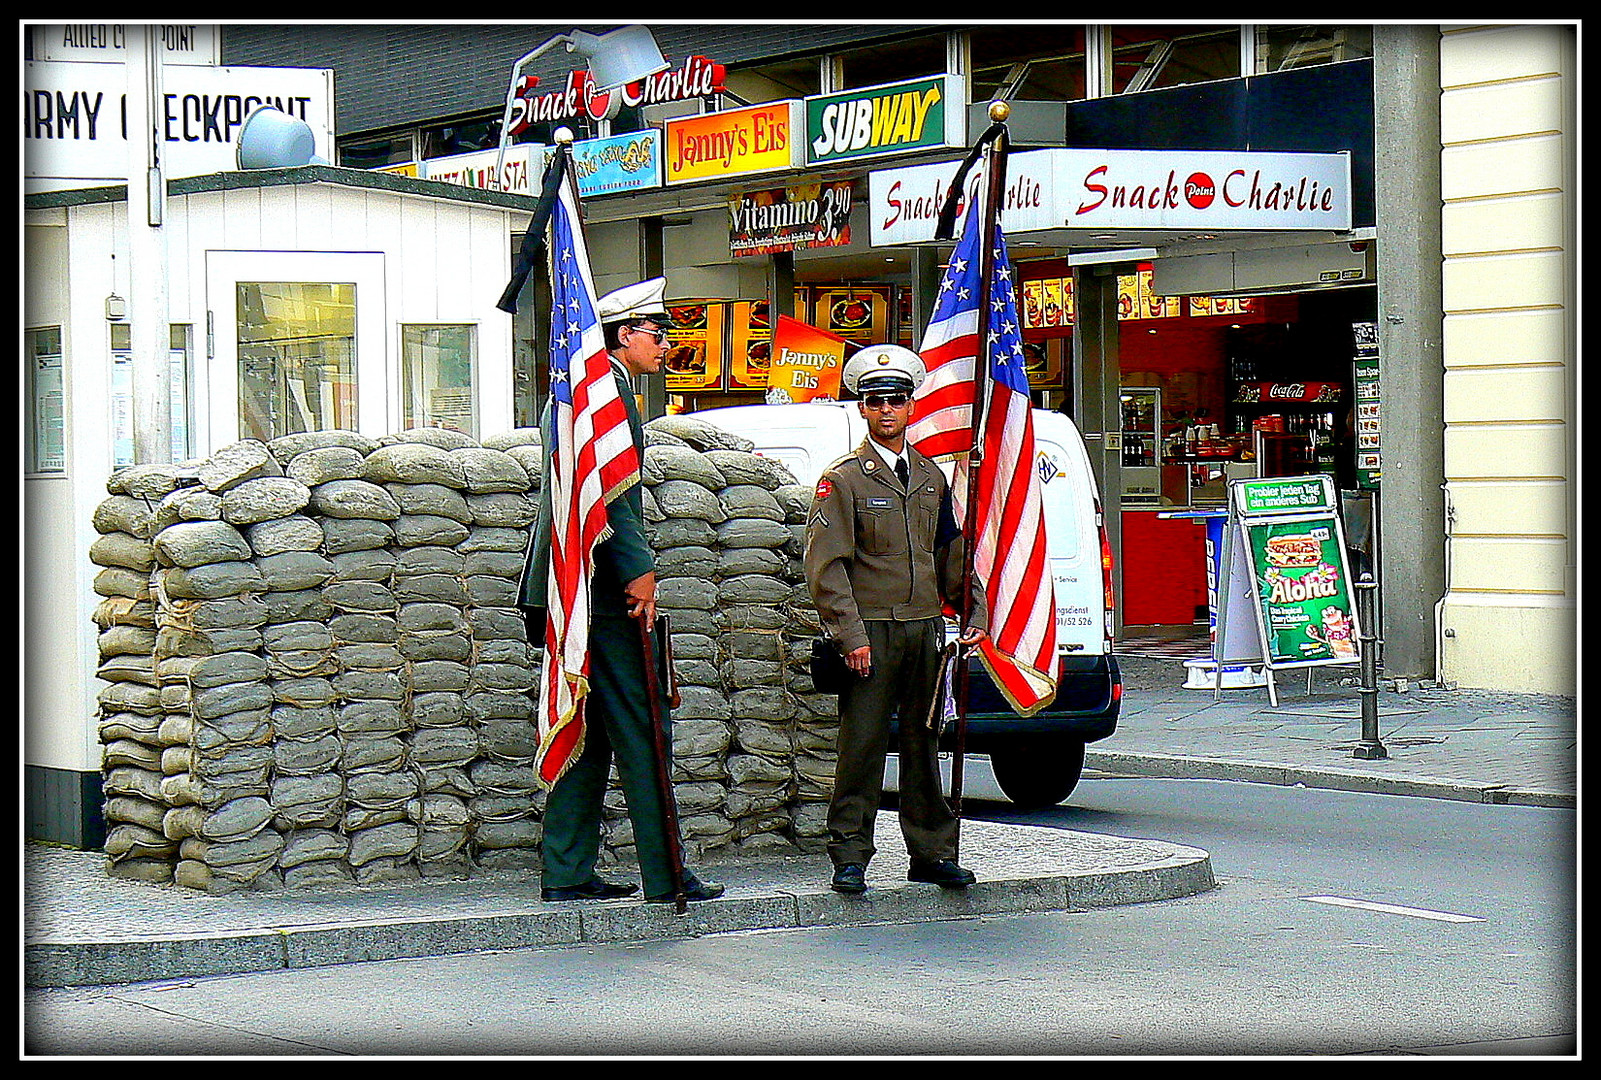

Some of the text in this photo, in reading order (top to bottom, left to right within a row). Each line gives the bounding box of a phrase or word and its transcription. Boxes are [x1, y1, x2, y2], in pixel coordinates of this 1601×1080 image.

[63, 24, 106, 48] ALLIED
[507, 70, 578, 131] Snack
[812, 84, 942, 159] SUBWAY
[673, 122, 748, 173] Janny's
[752, 112, 786, 154] Eis
[1076, 165, 1333, 215] Snack Point Charlie
[729, 198, 819, 234] Vitamino
[883, 179, 944, 231] Snack
[776, 347, 837, 371] Janny's
[790, 370, 819, 390] Eis
[1250, 494, 1318, 507] ein anderes Sub
[1280, 485, 1303, 498] jeden
[1303, 483, 1320, 496] Tag
[1268, 577, 1338, 604] Aloha
[1078, 617, 1093, 626] 526
